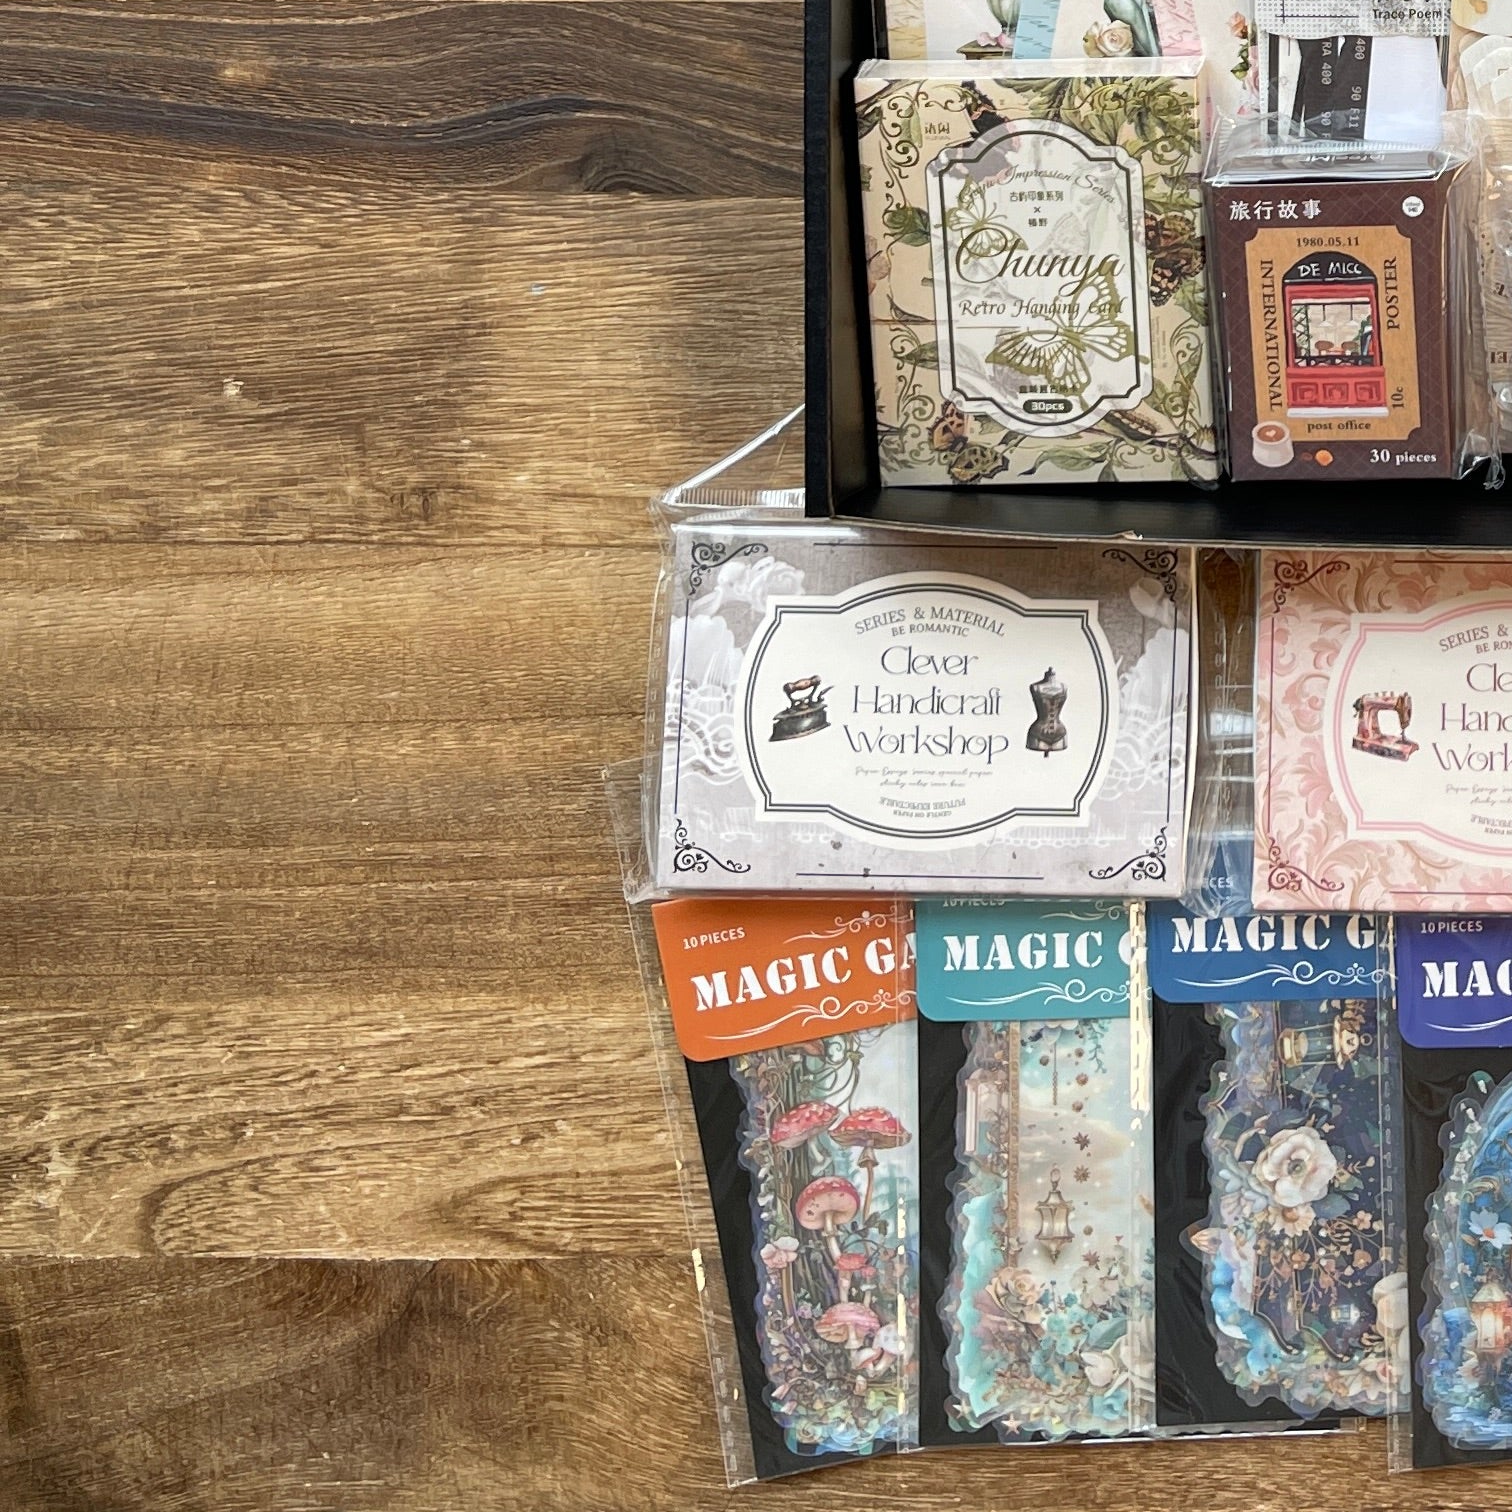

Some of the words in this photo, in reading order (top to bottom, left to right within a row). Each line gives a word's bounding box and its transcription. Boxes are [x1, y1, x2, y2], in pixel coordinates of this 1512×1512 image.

[1372, 8, 1405, 20] Trace
[1408, 8, 1443, 20] Poem
[1354, 37, 1366, 61] 400
[1321, 62, 1333, 86] 400
[1350, 86, 1362, 102] 90
[1229, 198, 1323, 222] 旅行故事
[1295, 236, 1361, 249] 1980.05.11
[954, 226, 1126, 298] Chunya
[1297, 262, 1321, 278] DE
[1383, 255, 1402, 331] POSTER
[958, 298, 1007, 316] Retro
[1012, 298, 1081, 321] Hanging
[1088, 296, 1126, 316] Card
[1259, 258, 1284, 412] INTERNATIONAL
[1306, 420, 1334, 434] post
[1336, 419, 1373, 432] office
[1369, 448, 1391, 464] 30
[1395, 450, 1438, 466] pieces
[853, 607, 908, 637] SERIES
[913, 605, 927, 621] &
[929, 605, 1007, 639] MATERIAL
[890, 626, 905, 639] BE
[907, 622, 970, 639] ROMANTIC
[1438, 624, 1491, 654] SERIES
[1496, 622, 1509, 637] &
[1474, 642, 1490, 655] BE
[880, 645, 980, 678] Clever
[852, 684, 1004, 717] Handicraft
[843, 724, 1010, 766] Workshop
[682, 934, 699, 950] 10
[700, 925, 746, 947] PIECES
[1171, 913, 1331, 955] MAGIC
[1419, 920, 1436, 934] 10
[1437, 919, 1484, 934] PIECES
[942, 931, 1105, 973] MAGIC
[689, 946, 853, 1013] MAGIC
